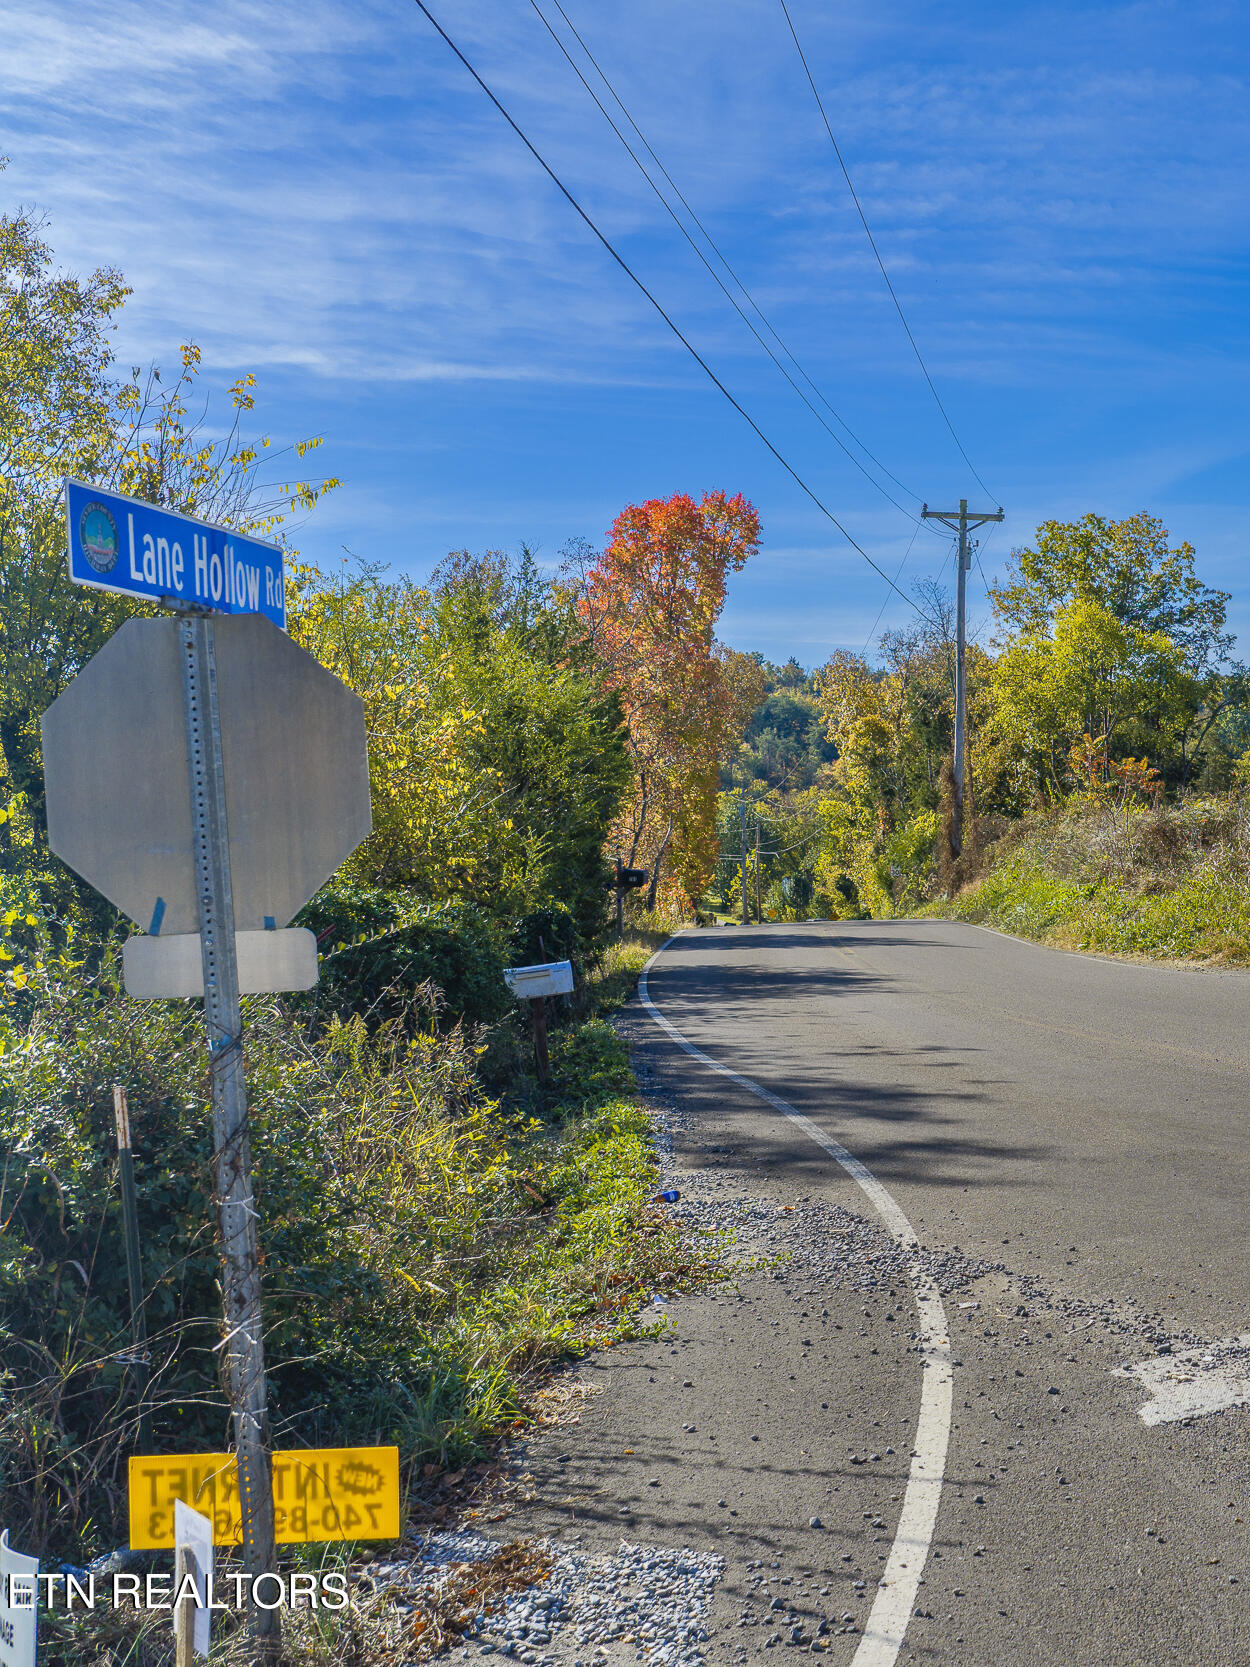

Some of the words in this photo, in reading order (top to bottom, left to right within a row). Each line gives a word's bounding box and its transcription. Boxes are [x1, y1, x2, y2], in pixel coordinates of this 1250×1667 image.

[127, 512, 185, 592] Lane
[193, 533, 260, 612] Hollow
[265, 565, 283, 609] Rd
